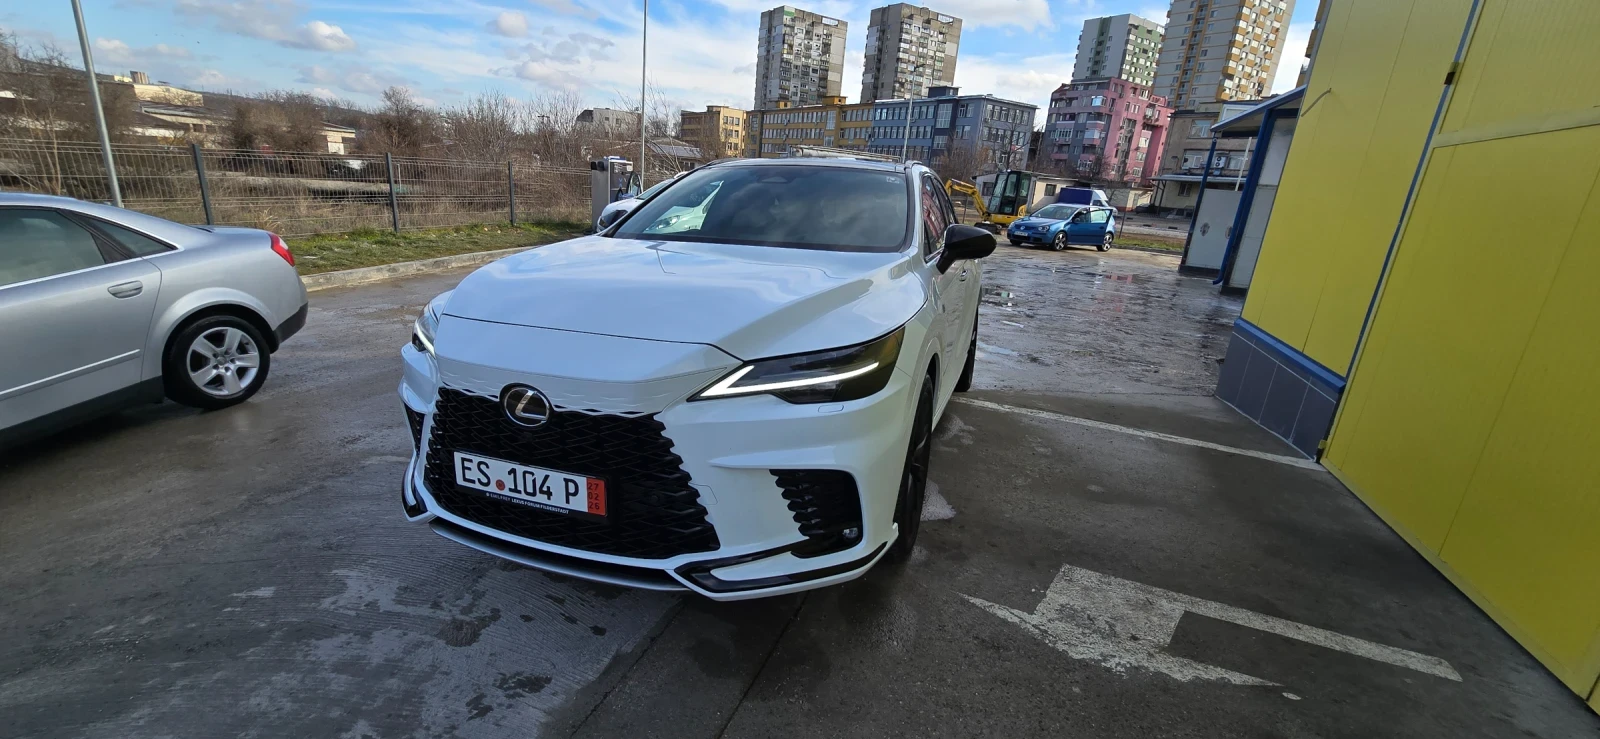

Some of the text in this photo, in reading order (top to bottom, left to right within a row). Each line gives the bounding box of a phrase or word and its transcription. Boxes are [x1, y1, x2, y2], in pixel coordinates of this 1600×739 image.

[461, 457, 579, 504] ES 104 P
[588, 482, 599, 490] 27
[588, 491, 599, 500] 02
[588, 501, 600, 510] 26
